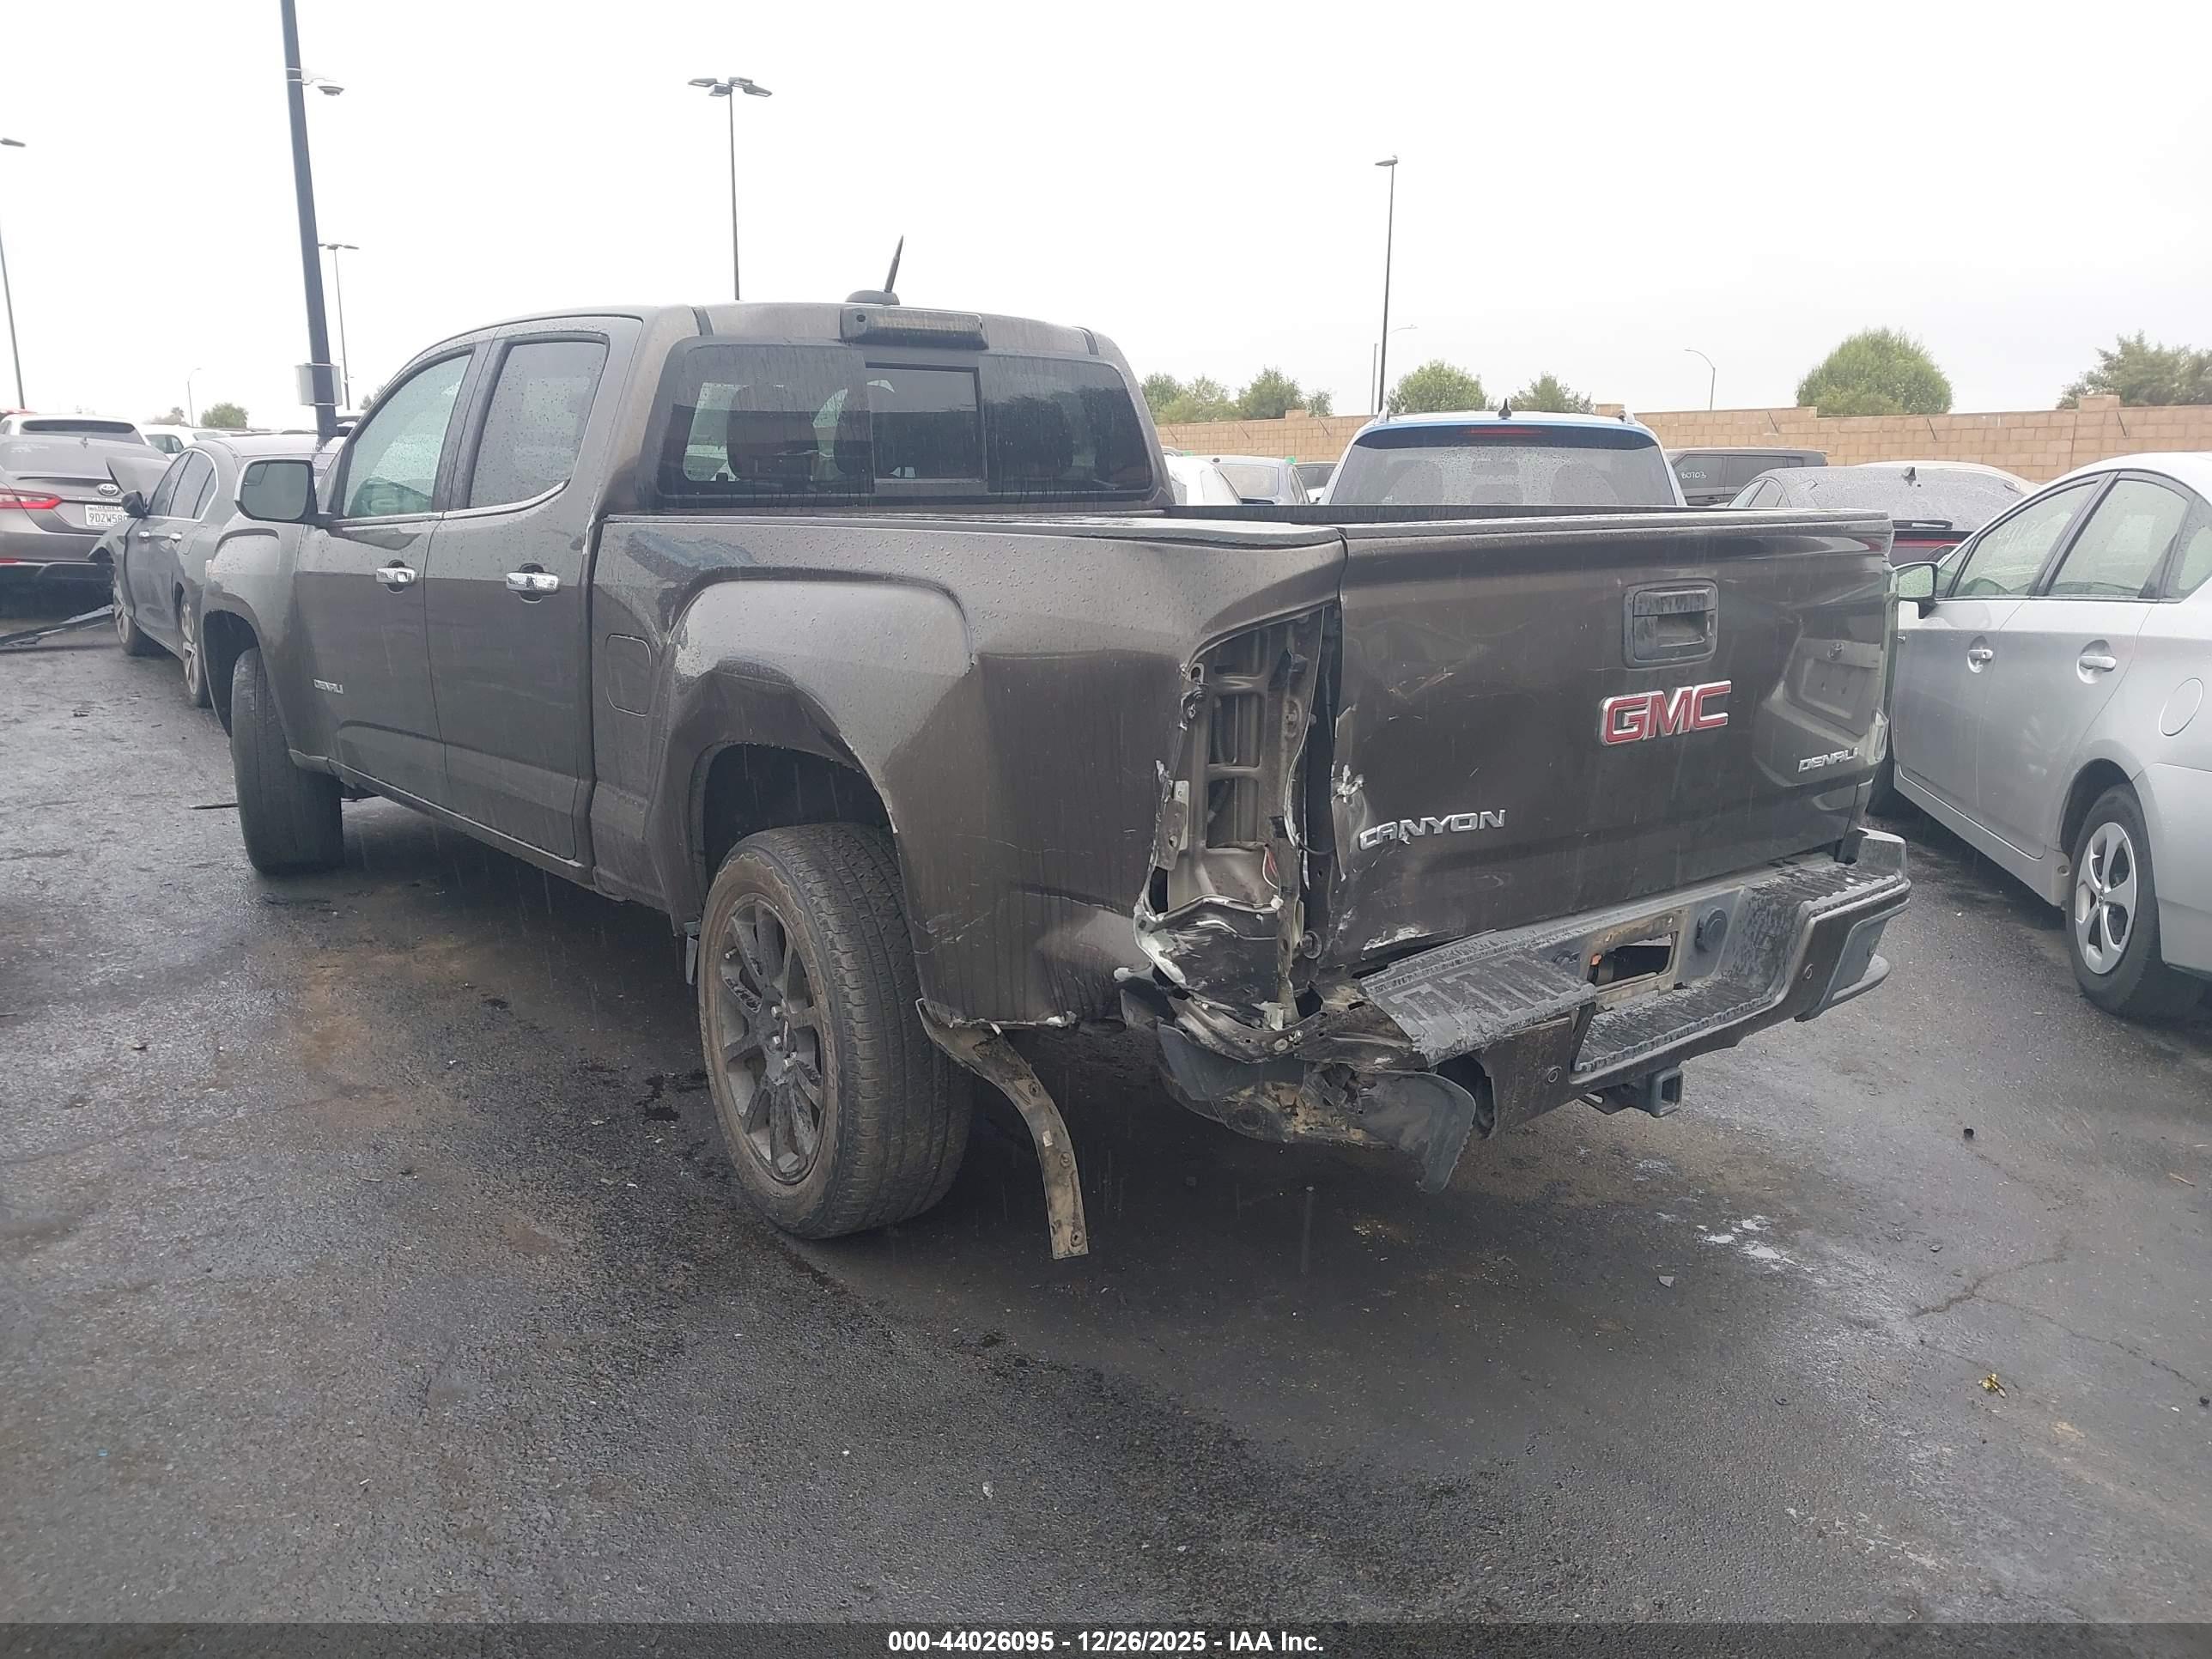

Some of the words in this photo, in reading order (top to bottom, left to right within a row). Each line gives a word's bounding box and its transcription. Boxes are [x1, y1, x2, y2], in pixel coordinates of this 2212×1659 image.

[1599, 679, 1732, 747] GMC
[1797, 746, 1859, 774] DENALI
[1358, 809, 1506, 851] CANYON
